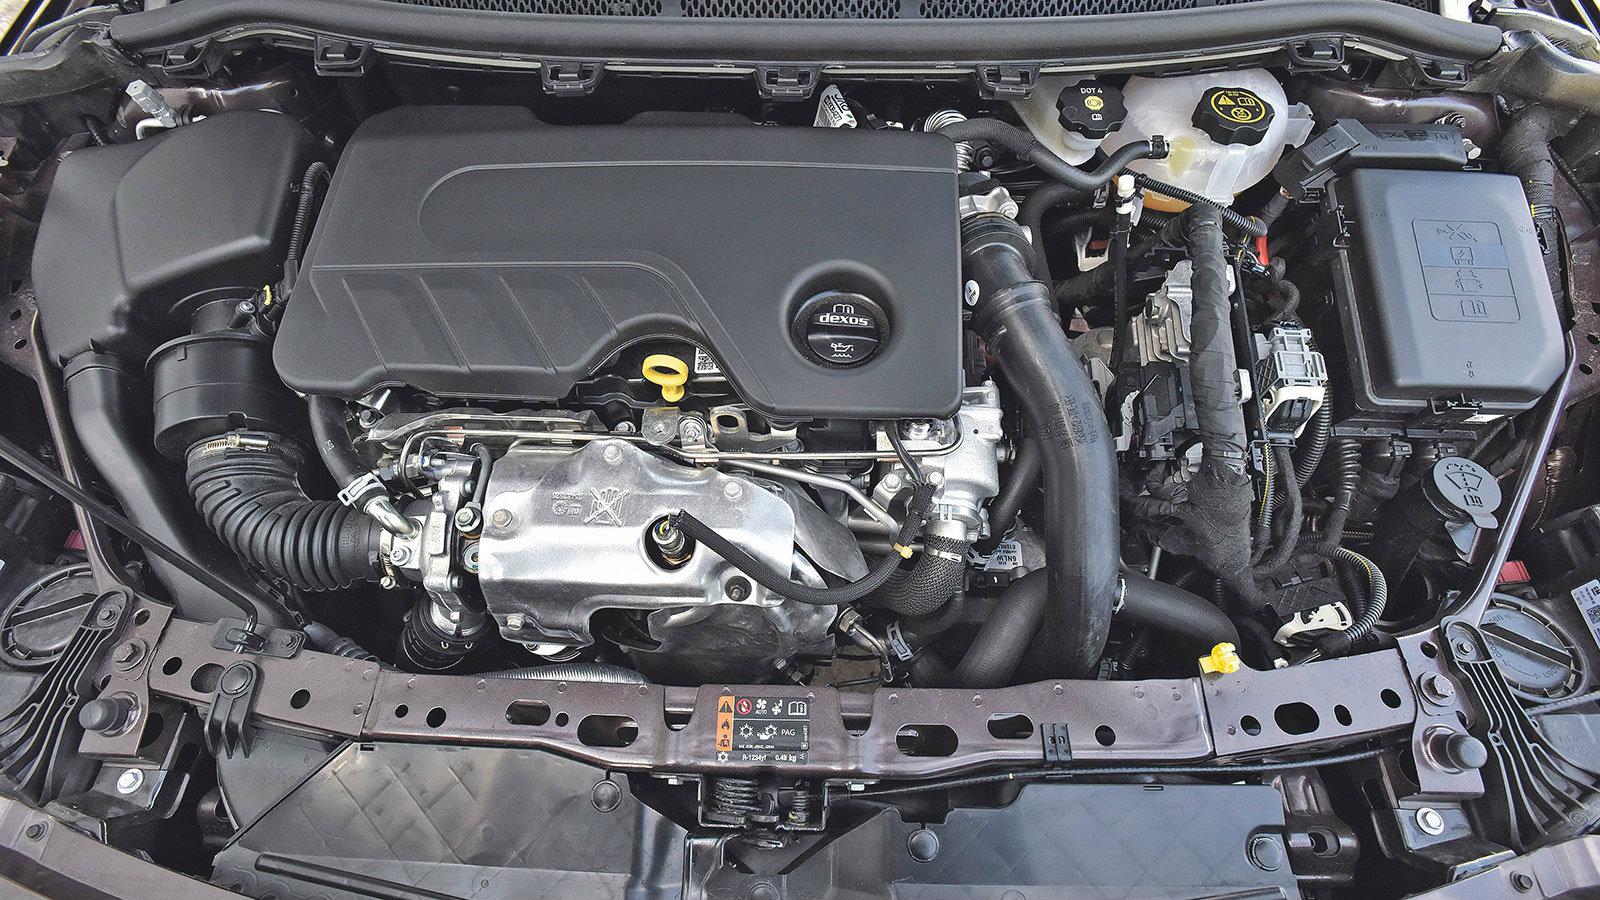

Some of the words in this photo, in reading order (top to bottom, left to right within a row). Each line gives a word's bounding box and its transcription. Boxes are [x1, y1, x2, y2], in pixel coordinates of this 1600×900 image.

[819, 313, 869, 326] dexos
[742, 754, 767, 762] R-1234yf
[789, 753, 797, 763] kg
